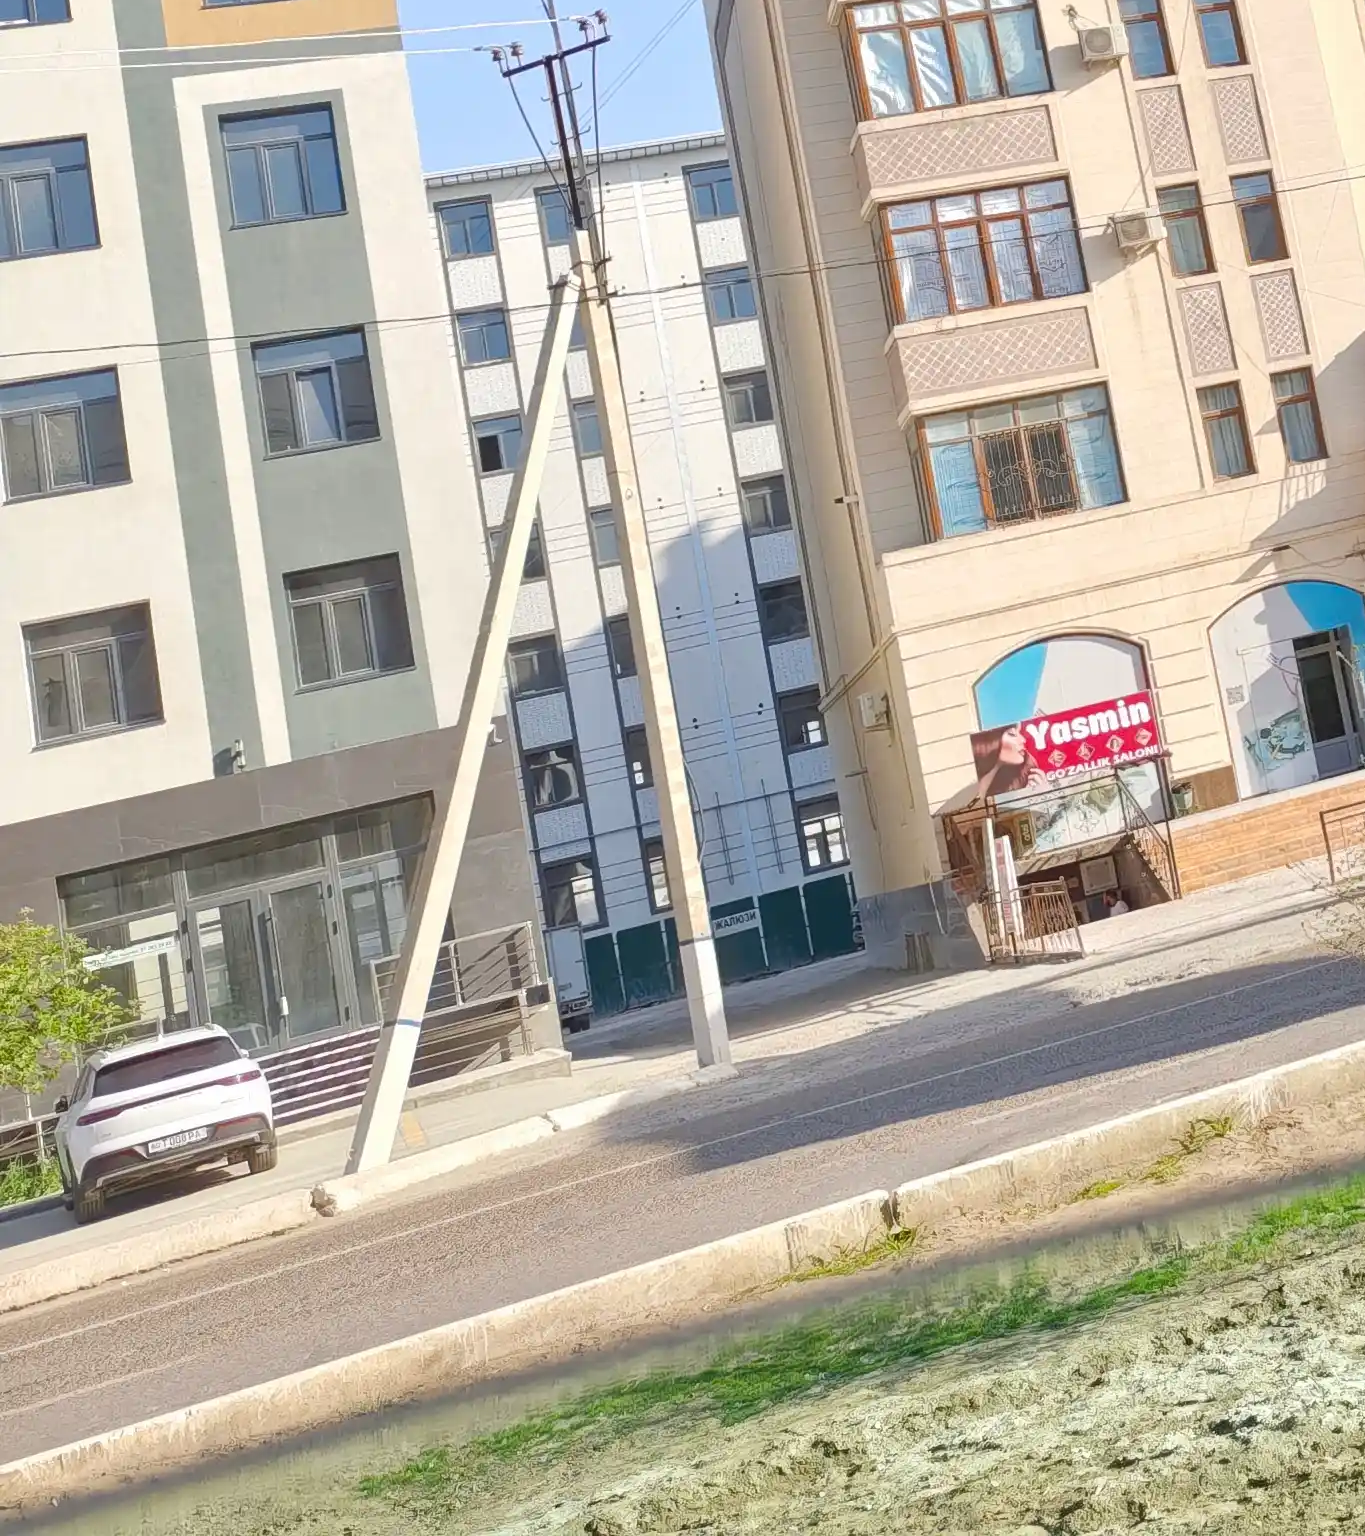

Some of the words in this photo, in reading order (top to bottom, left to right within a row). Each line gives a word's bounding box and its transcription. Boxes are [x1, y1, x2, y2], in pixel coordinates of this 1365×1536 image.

[1026, 700, 1151, 750] Yasmin
[1112, 744, 1159, 763] SALONI
[714, 911, 757, 931] ЖАЛЮЗИ
